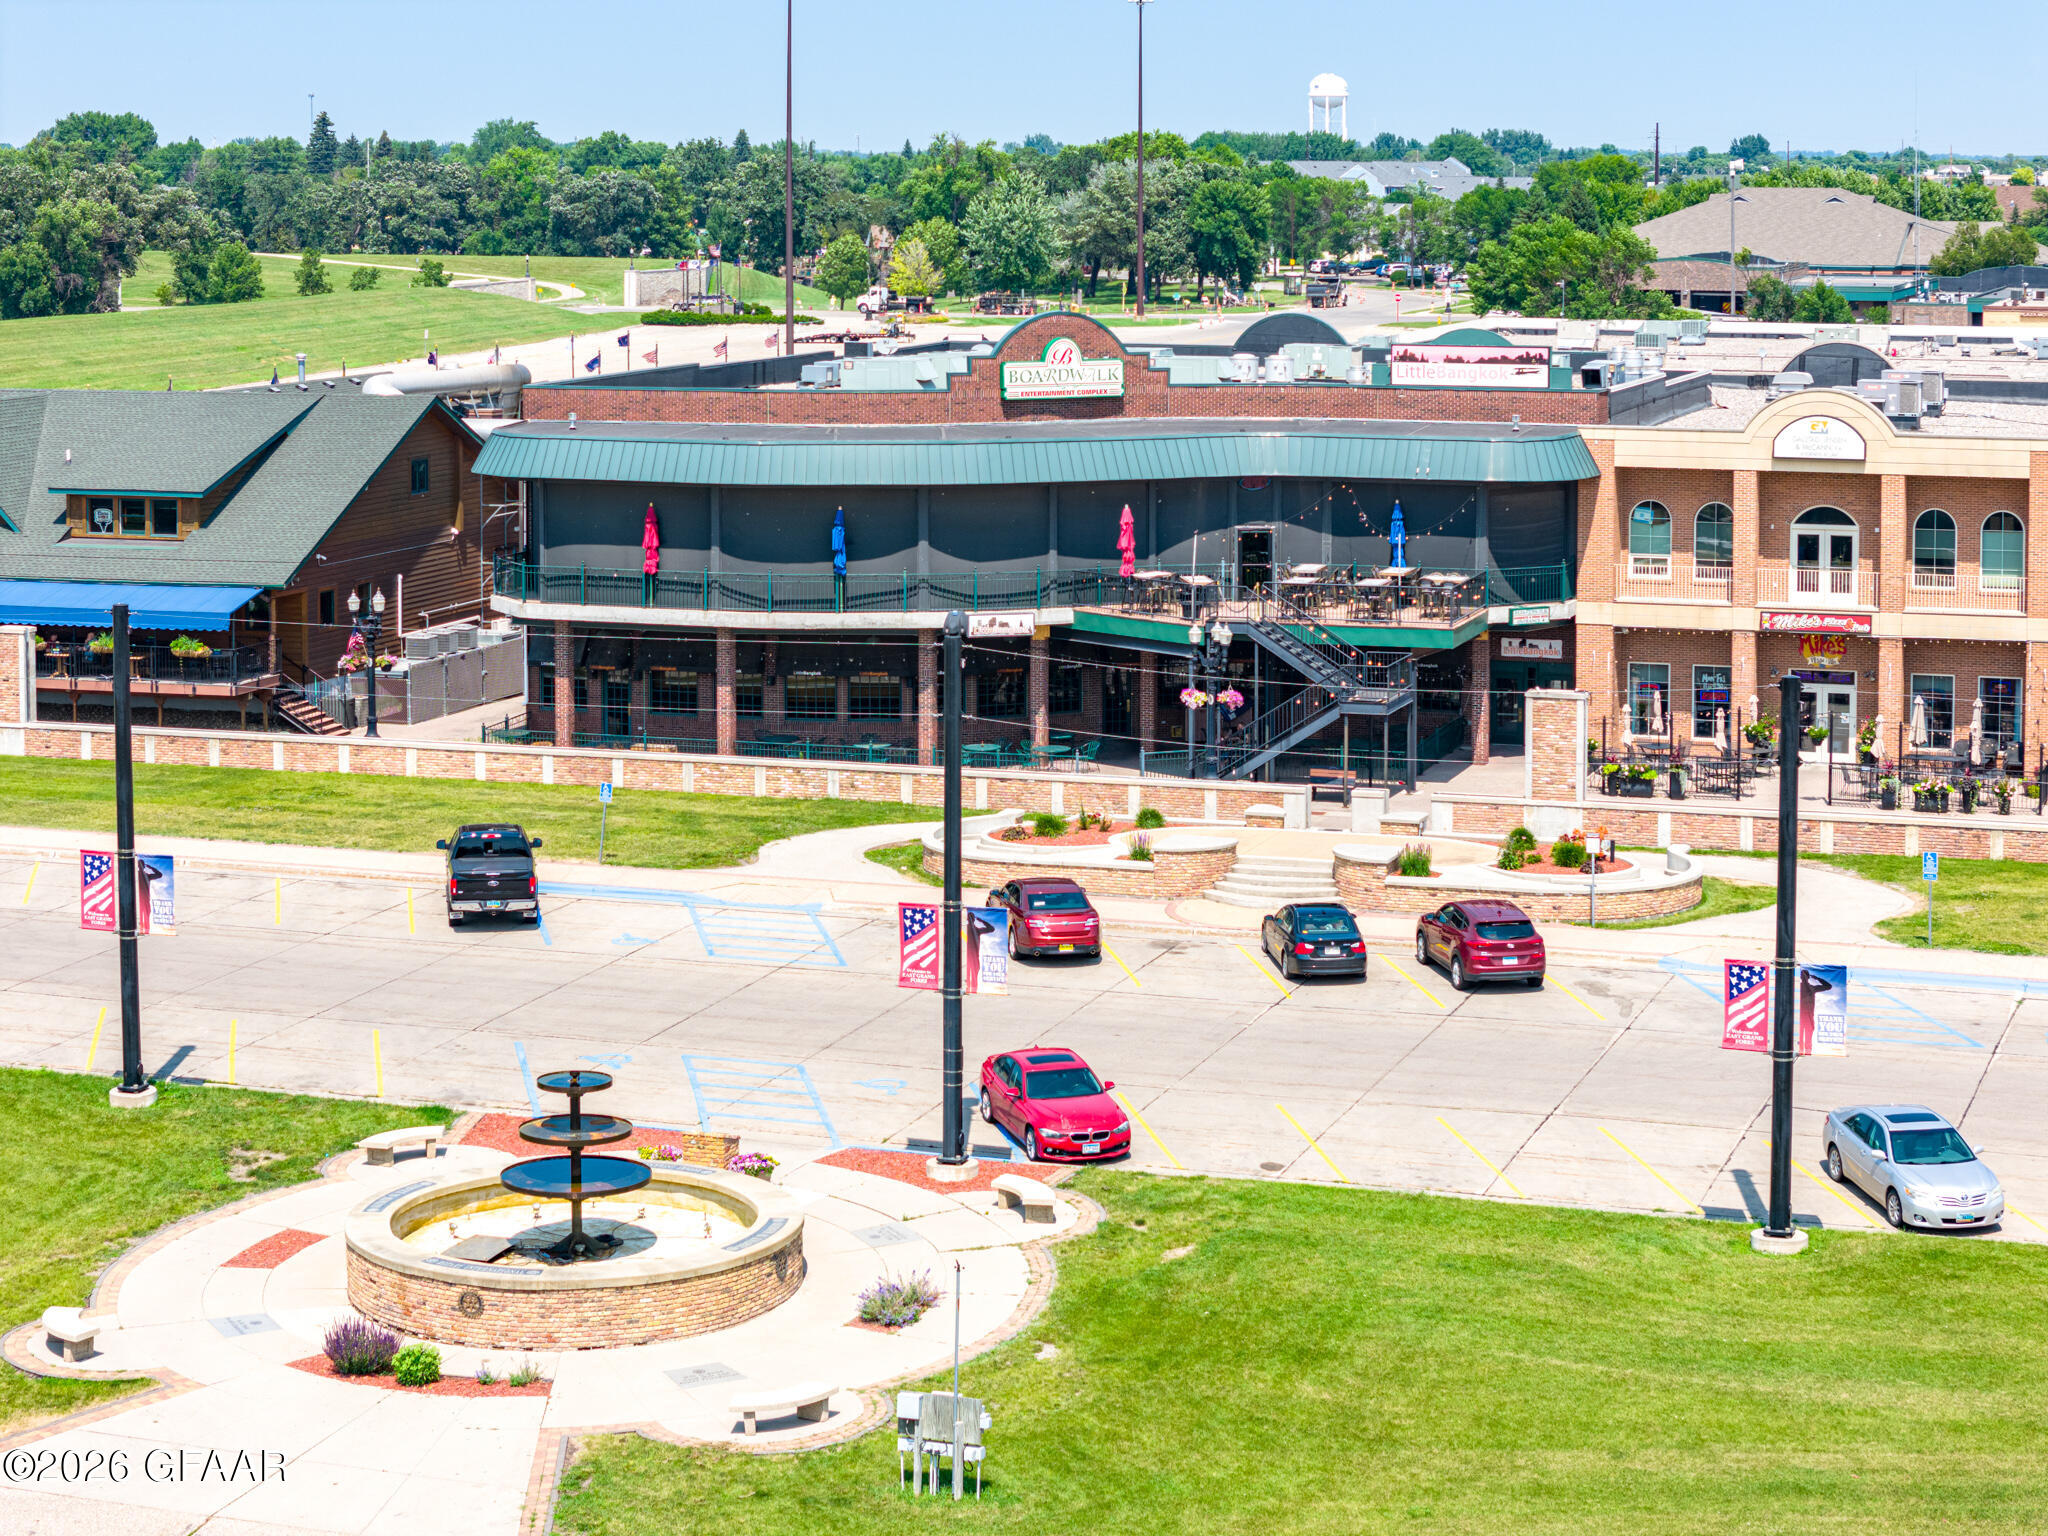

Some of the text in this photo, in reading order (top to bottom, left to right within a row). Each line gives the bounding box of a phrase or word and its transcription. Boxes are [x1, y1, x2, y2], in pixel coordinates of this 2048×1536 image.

[1051, 347, 1073, 365] B
[1009, 367, 1119, 386] BOARDWALK
[1396, 364, 1508, 382] LittleBangkok
[1021, 388, 1108, 397] ENTERTAINMENT COMPLEX
[1772, 614, 1822, 630] Mike's
[1798, 634, 1847, 656] Mike's
[154, 905, 173, 915] YOU
[984, 962, 1005, 972] YOU
[1818, 1022, 1843, 1032] YOU
